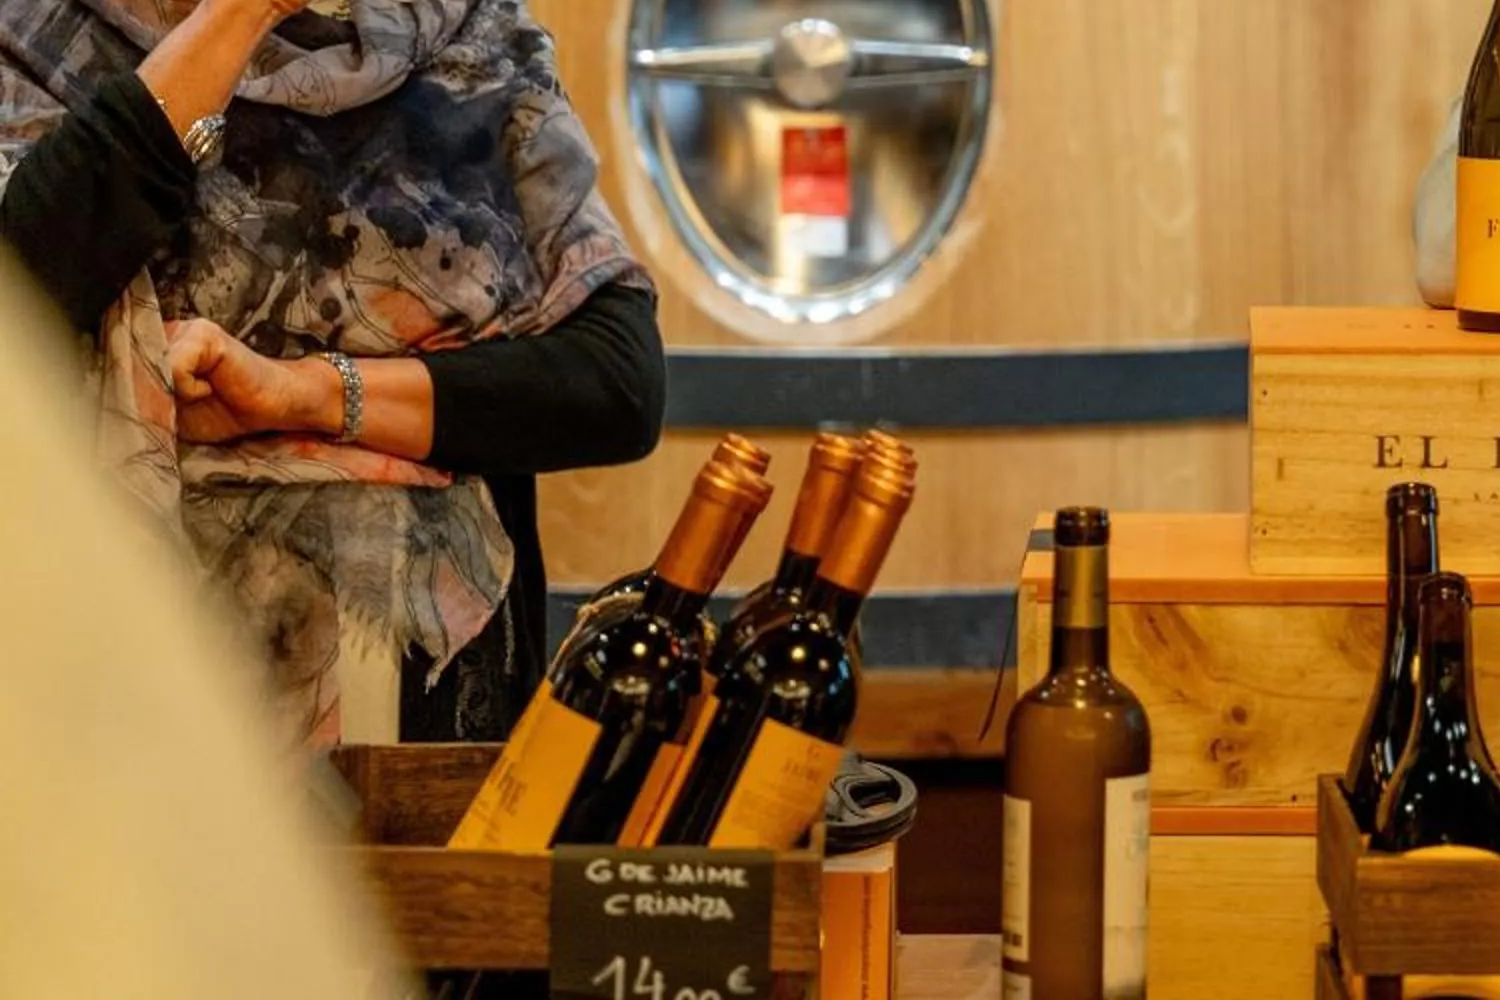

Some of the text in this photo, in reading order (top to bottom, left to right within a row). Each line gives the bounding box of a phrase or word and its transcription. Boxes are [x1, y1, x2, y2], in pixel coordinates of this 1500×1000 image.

[1373, 434, 1448, 469] EL
[584, 858, 749, 888] G DE JAIME
[604, 890, 735, 921] CRIANZA
